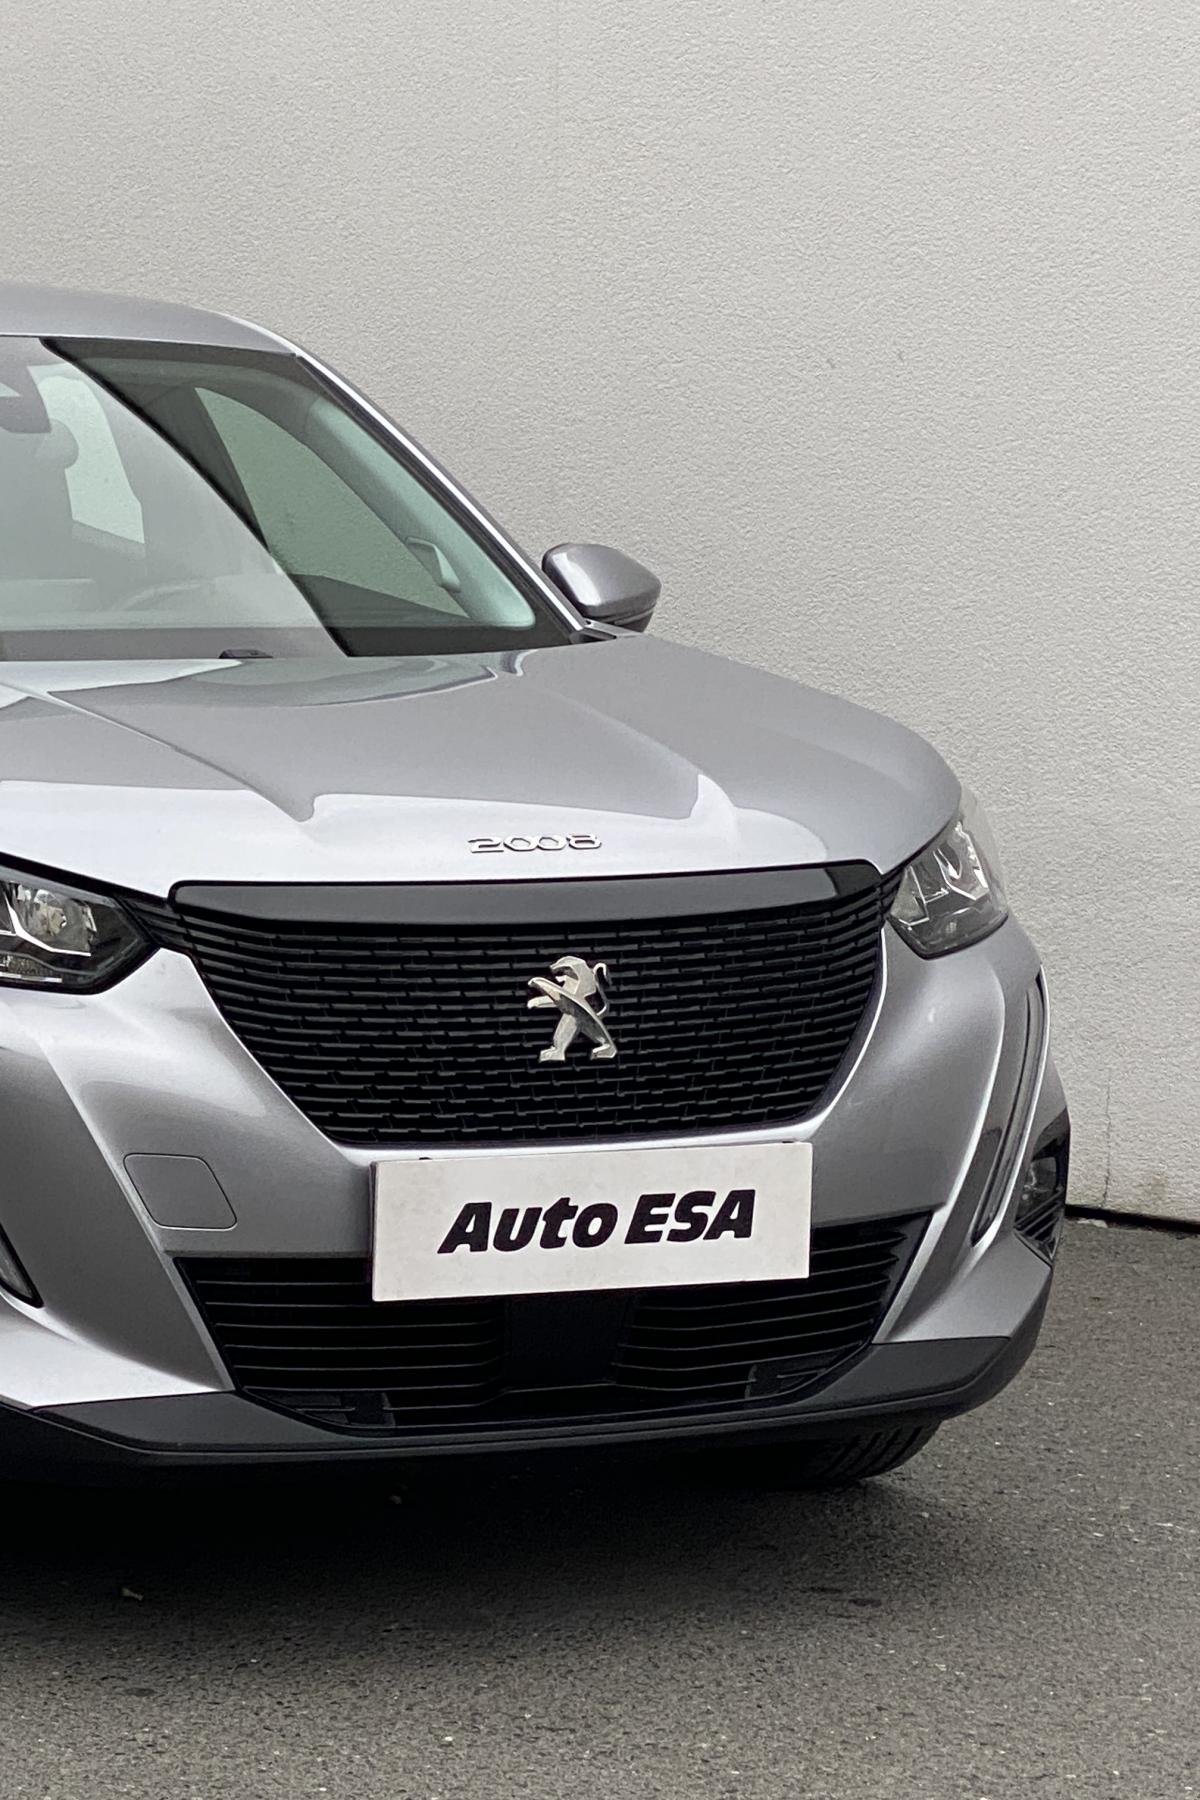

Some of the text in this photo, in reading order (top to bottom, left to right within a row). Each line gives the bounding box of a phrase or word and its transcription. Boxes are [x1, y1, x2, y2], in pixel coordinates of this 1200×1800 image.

[468, 833, 602, 853] 2008
[437, 1189, 756, 1254] Auto ESA
